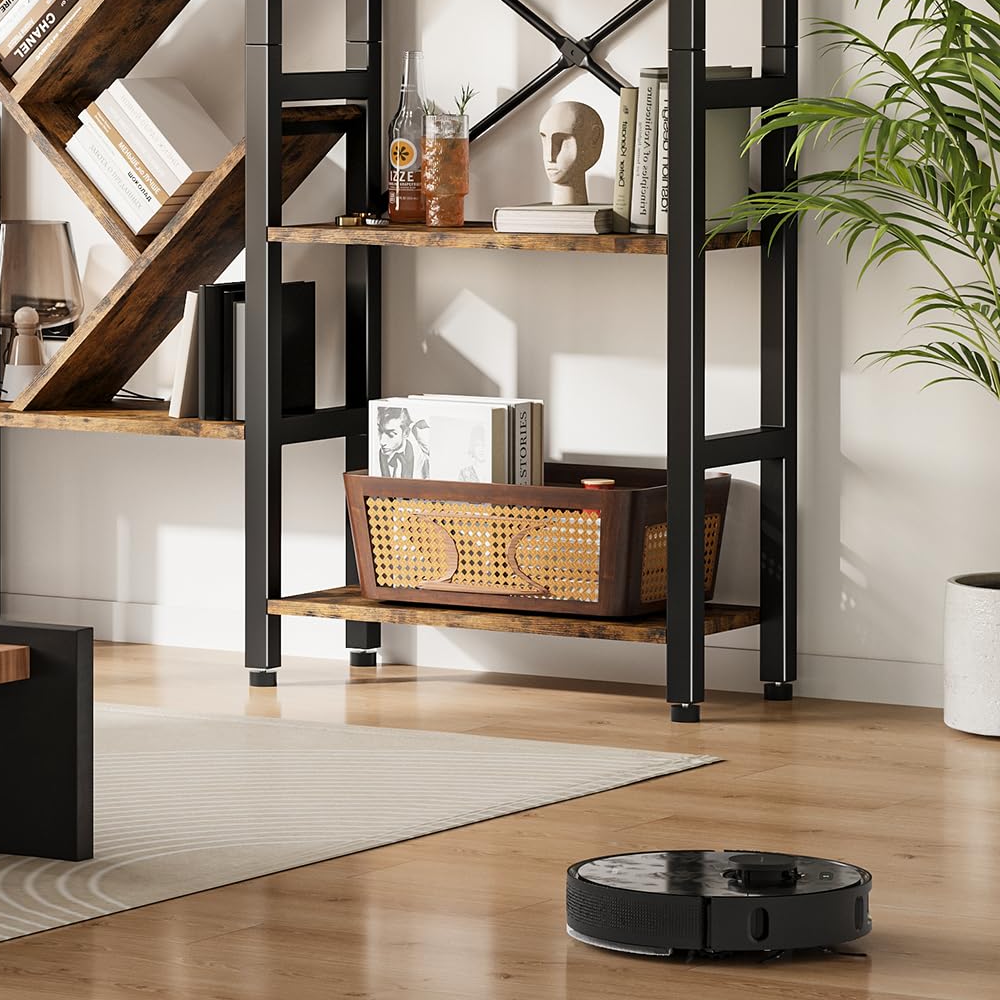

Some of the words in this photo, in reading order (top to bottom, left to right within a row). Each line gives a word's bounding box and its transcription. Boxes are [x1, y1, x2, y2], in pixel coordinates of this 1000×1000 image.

[12, 11, 57, 60] CHANEL
[390, 171, 414, 182] IZZE
[520, 411, 528, 478] STORIES
